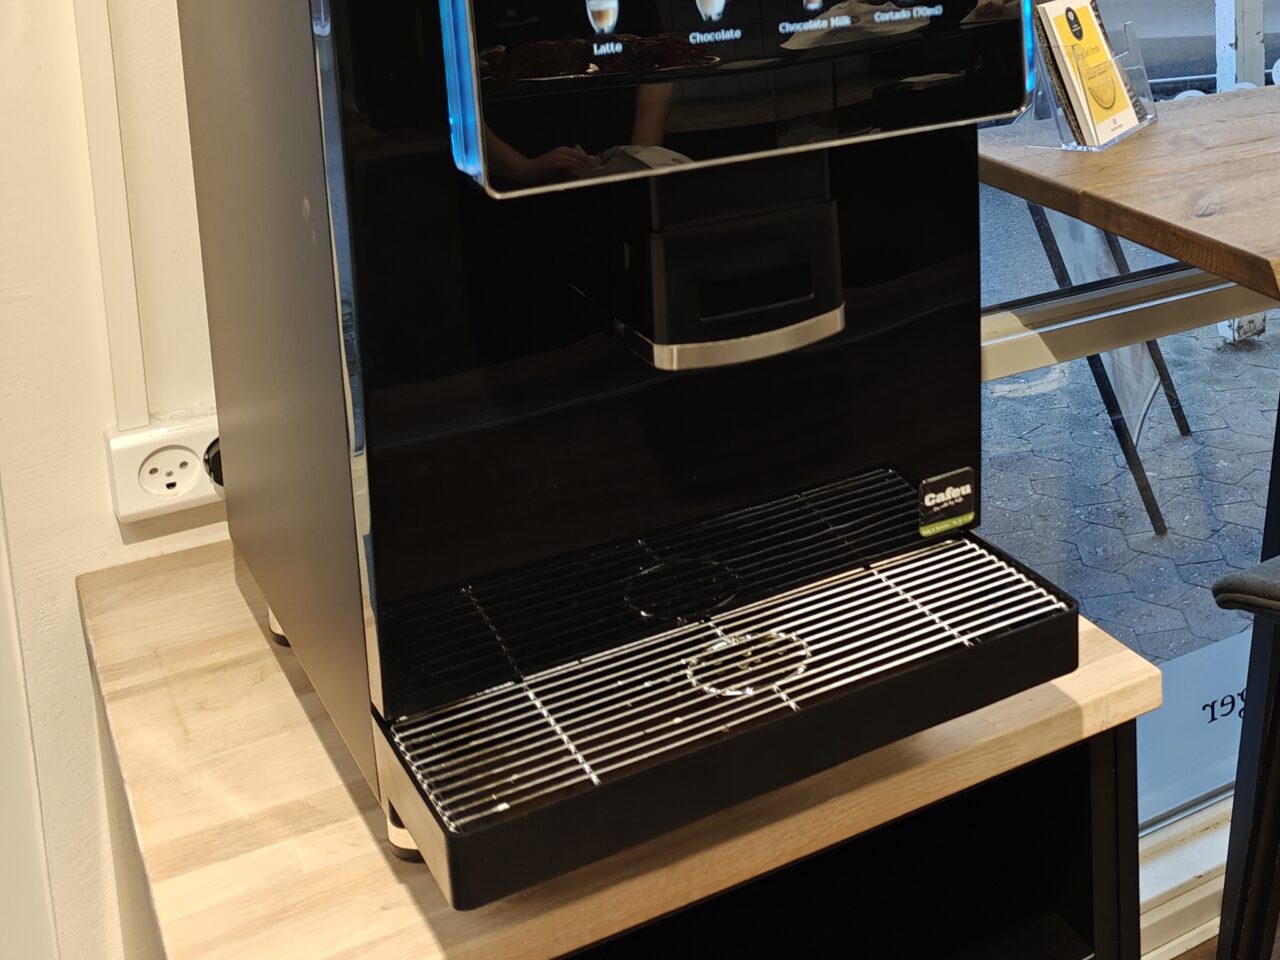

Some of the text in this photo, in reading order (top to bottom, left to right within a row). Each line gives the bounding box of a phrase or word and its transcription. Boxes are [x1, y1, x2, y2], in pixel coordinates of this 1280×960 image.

[778, 15, 852, 34] Chocolate Milk
[688, 28, 742, 45] Chocolate
[593, 41, 623, 56] Latte
[924, 483, 972, 507] Cafeu
